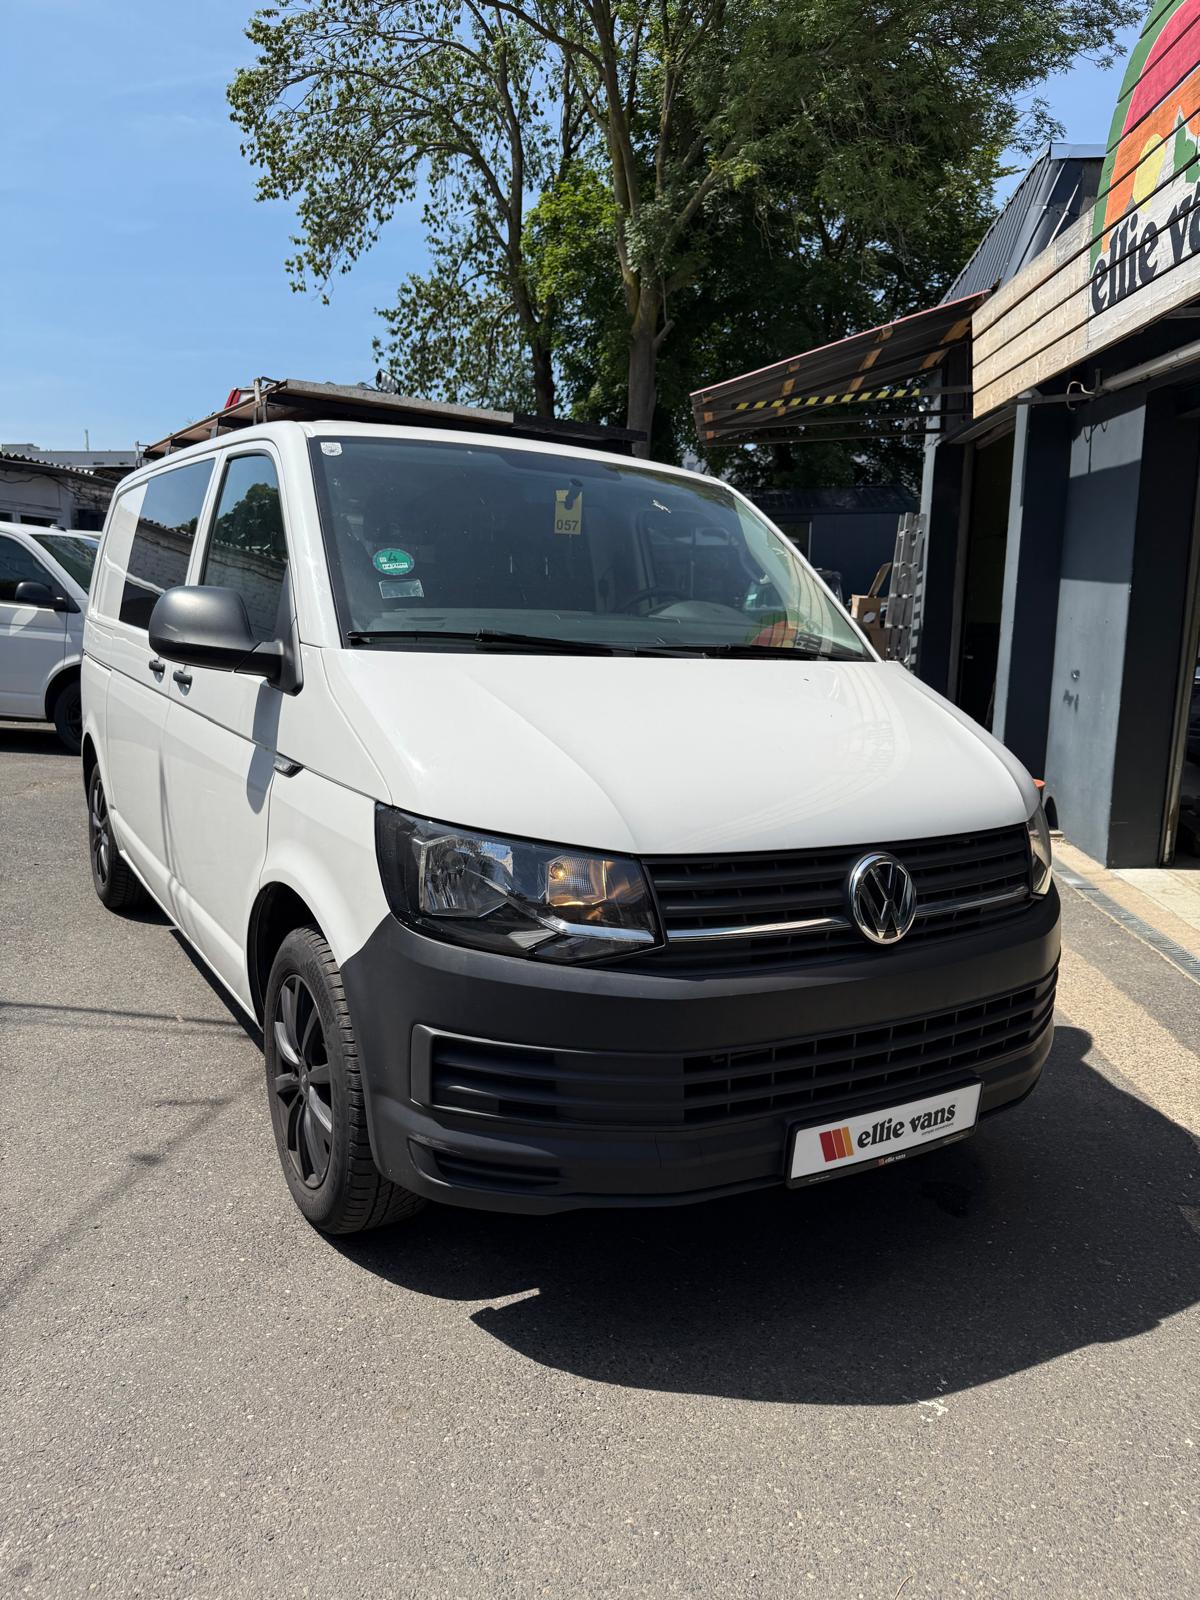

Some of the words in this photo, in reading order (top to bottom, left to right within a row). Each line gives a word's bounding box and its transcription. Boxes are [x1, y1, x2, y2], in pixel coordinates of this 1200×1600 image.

[1091, 212, 1159, 314] ellie
[556, 519, 578, 531] 057
[857, 1117, 905, 1149] ellie
[909, 1103, 956, 1133] vans
